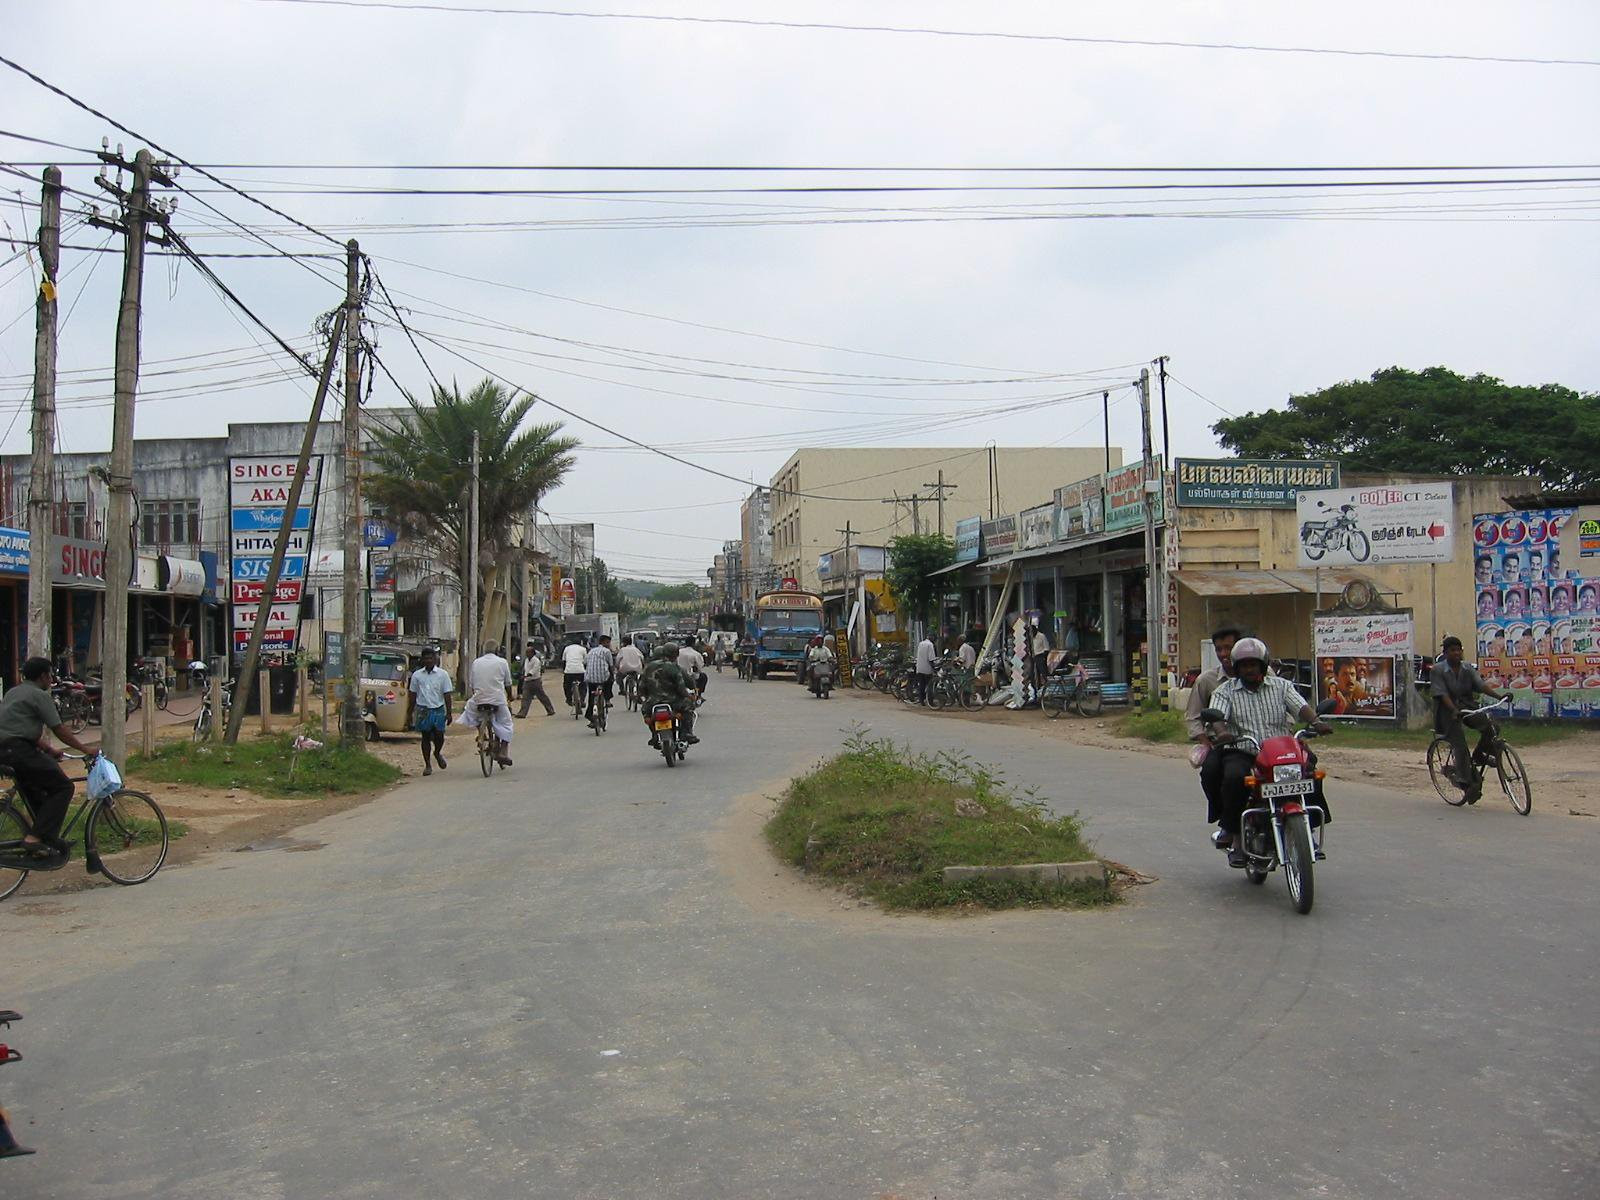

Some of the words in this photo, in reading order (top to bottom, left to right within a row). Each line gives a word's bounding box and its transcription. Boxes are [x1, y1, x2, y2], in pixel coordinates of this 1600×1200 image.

[251, 488, 291, 501] AKA
[1360, 489, 1403, 506] BOXER
[1404, 492, 1421, 501] CT
[62, 544, 105, 578] SING
[238, 559, 297, 577] SISL
[237, 583, 296, 600] Preige
[239, 611, 290, 622] TEAL
[245, 631, 284, 640] Nonal
[240, 641, 288, 651] Psonic
